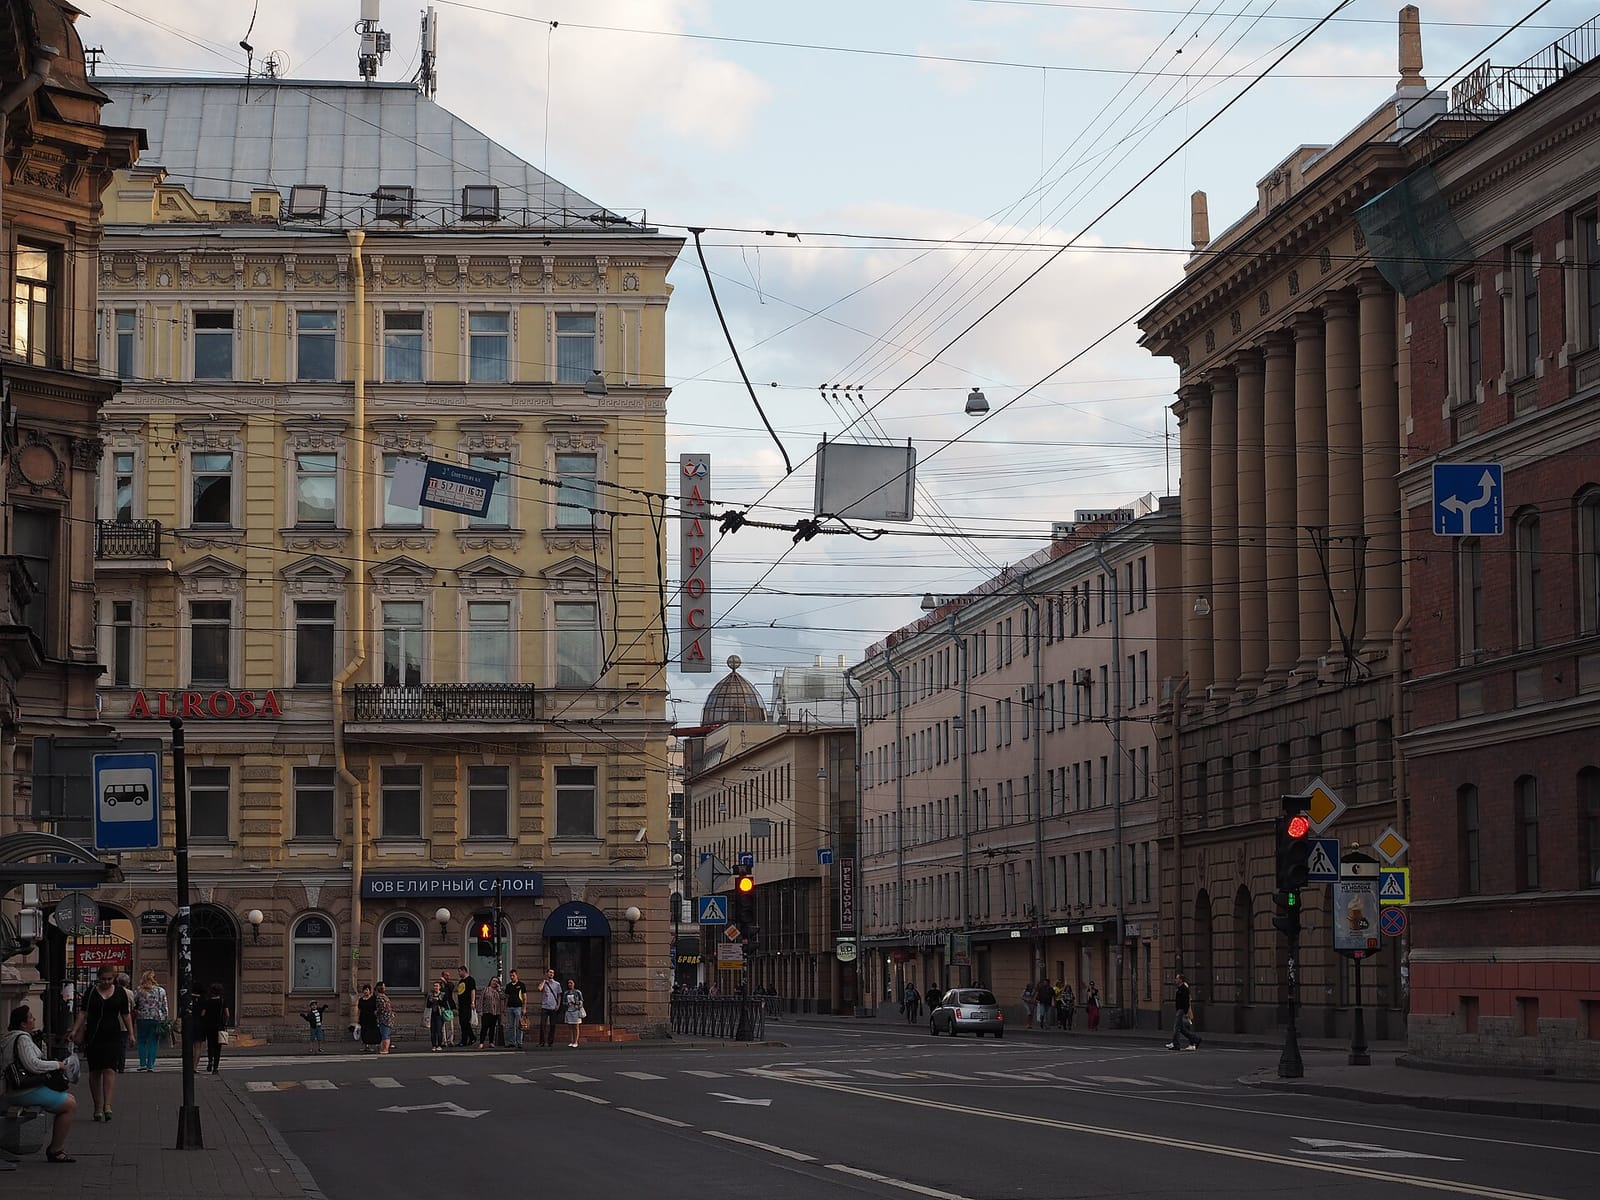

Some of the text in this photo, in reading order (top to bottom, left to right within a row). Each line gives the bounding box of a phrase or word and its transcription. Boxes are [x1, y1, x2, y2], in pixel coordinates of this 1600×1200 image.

[687, 484, 706, 661] АЛРОСА
[128, 690, 284, 719] ALROSA
[371, 878, 474, 893] ЮВЕЛИРНЫЙ
[843, 867, 852, 922] РЕСТОРАН
